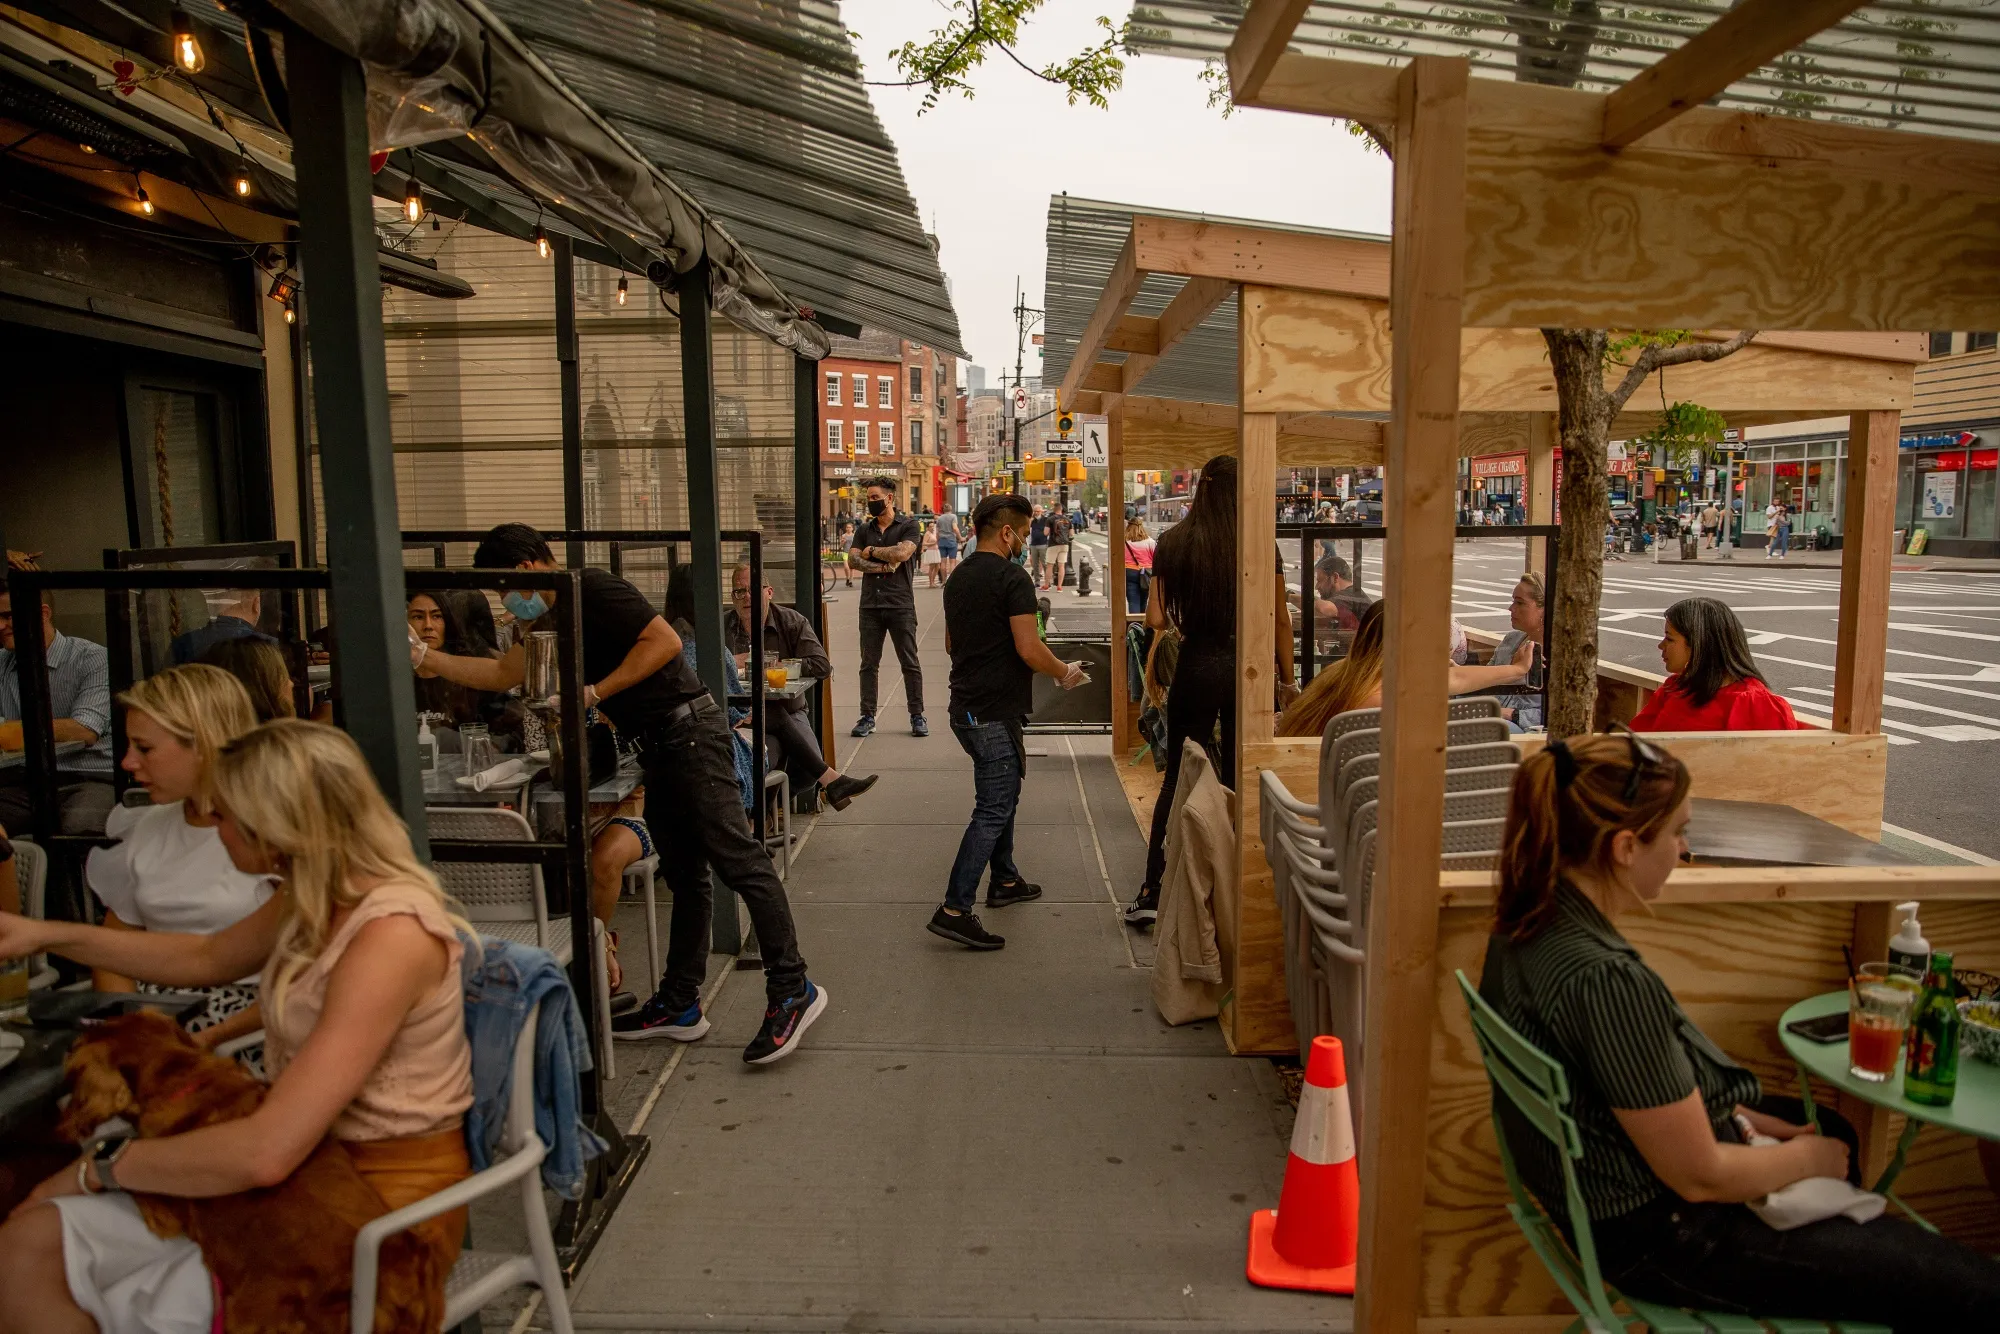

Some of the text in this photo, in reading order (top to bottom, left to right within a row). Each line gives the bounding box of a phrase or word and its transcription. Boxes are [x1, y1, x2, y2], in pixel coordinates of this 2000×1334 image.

[1087, 456, 1106, 464] ONLY
[834, 467, 898, 476] STARS COFFEE
[1475, 460, 1520, 474] VILLAGE CIGARS
